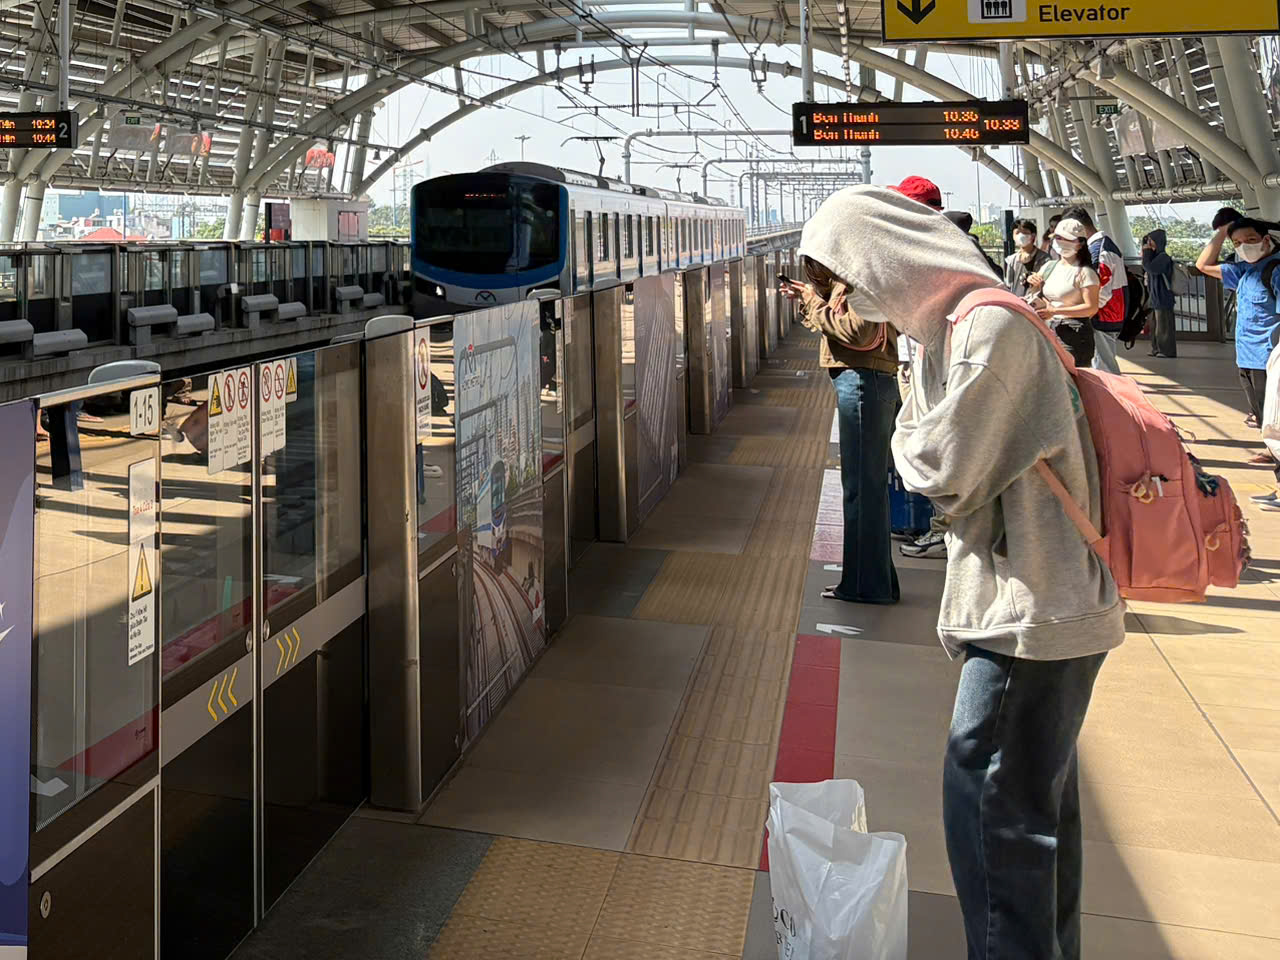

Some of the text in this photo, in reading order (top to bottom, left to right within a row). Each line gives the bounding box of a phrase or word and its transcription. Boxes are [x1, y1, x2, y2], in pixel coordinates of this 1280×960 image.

[1038, 4, 1131, 23] Elevator
[1100, 106, 1115, 114] EXIT
[31, 119, 56, 129] 10:34
[58, 122, 68, 138] 2
[799, 115, 807, 134] 1
[31, 133, 56, 143] 10:44
[133, 396, 154, 429] 1-15
